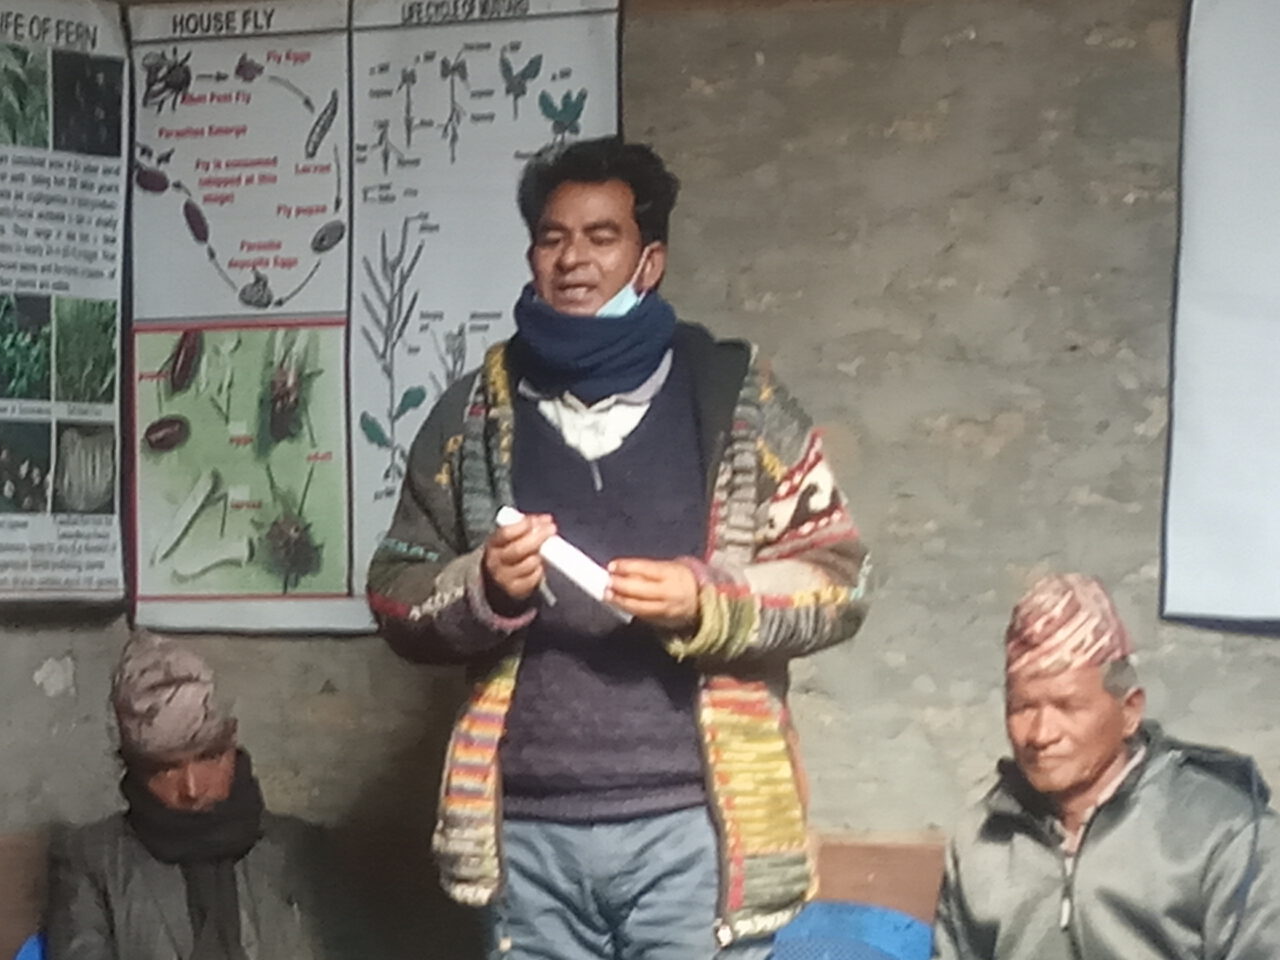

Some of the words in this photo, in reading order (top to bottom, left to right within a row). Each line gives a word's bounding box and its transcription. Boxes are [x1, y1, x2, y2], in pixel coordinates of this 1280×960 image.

[28, 15, 51, 41] OF
[55, 19, 98, 49] FERN
[172, 13, 237, 34] HOUSE
[242, 9, 275, 30] FLY
